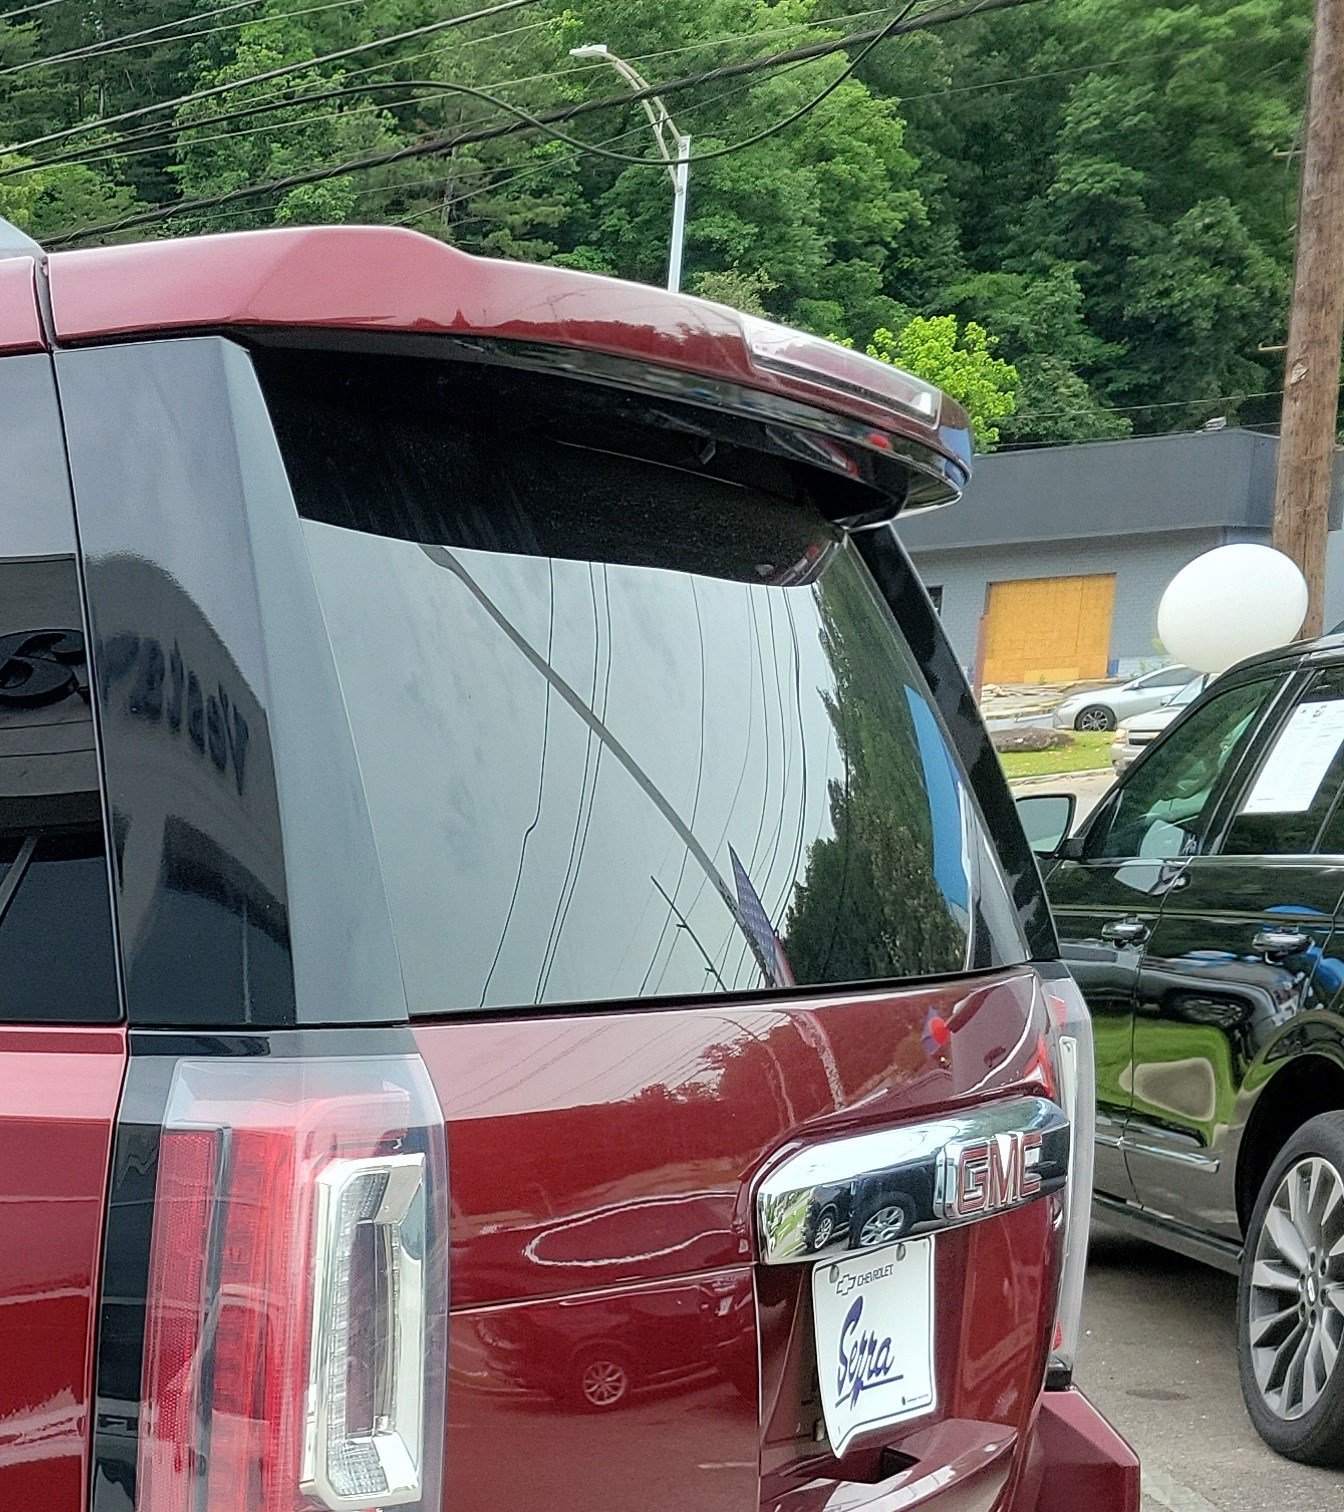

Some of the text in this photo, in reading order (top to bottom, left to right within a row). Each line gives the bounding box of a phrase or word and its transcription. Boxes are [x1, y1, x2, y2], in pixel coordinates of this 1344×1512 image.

[955, 1130, 1044, 1210] GMC
[856, 1263, 894, 1287] CHEVROLET
[835, 1294, 902, 1411] Serra
